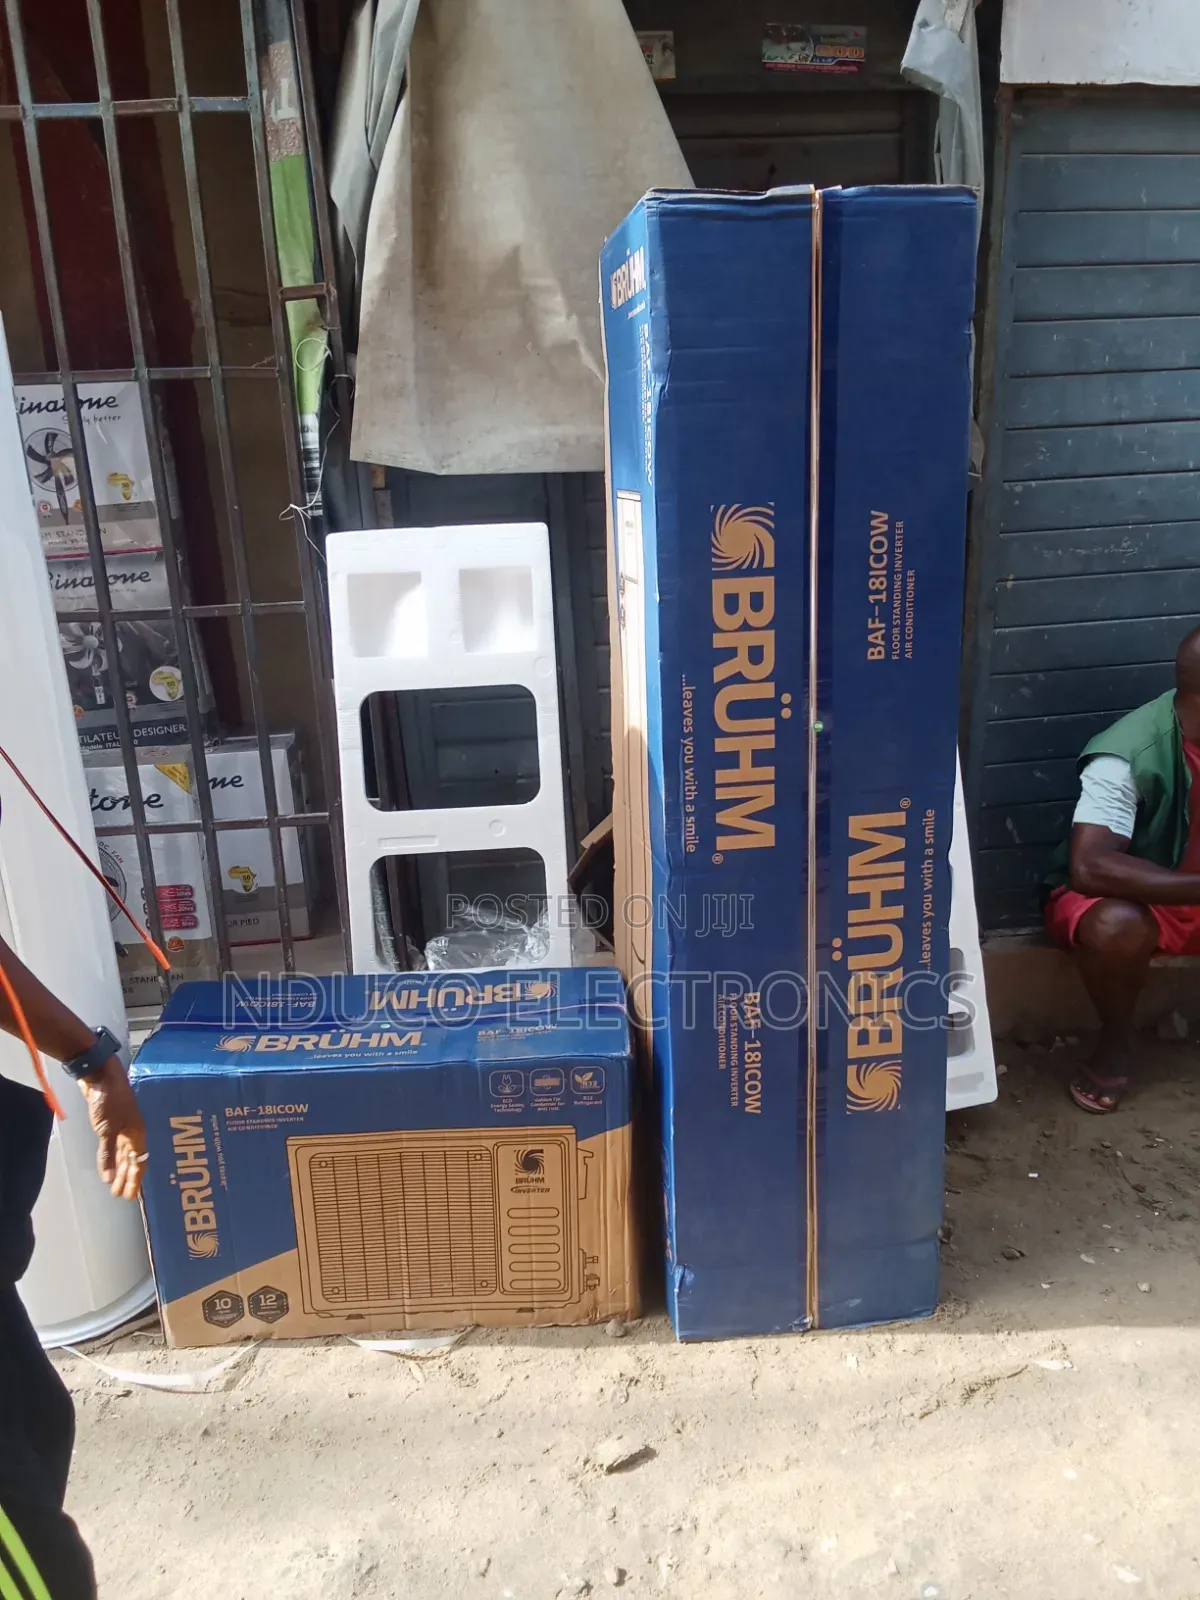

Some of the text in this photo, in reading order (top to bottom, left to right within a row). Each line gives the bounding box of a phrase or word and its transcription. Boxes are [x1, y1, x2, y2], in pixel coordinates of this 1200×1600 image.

[616, 245, 645, 309] BRÜHM
[93, 414, 121, 423] better
[867, 510, 889, 660] BAF-18ICOW
[892, 520, 904, 660] FLOOR STANDING INVERTER
[904, 569, 915, 659] AIR CONDITIONER
[712, 576, 791, 851] BRÜHM
[133, 723, 187, 738] DESIGNER
[681, 736, 694, 763] you
[685, 767, 698, 800] with
[686, 804, 695, 812] a
[686, 816, 699, 853] smile
[922, 808, 935, 845] smile
[925, 847, 933, 856] a
[921, 859, 933, 891] with
[922, 893, 935, 917] you
[831, 811, 907, 1059] BRÜHM
[255, 1029, 422, 1052] BRÜHM
[717, 994, 726, 1070] AIR CONDITIONER
[729, 993, 739, 1107] FLOOR STANDING INVERTER
[743, 992, 761, 1115] BAF-18ICOW
[210, 1114, 219, 1131] smile
[225, 1104, 309, 1118] BAF-18ICOW
[214, 1136, 222, 1152] with
[170, 1115, 217, 1232] BRÜHM
[214, 1297, 232, 1311] 10
[259, 1294, 277, 1306] 12
